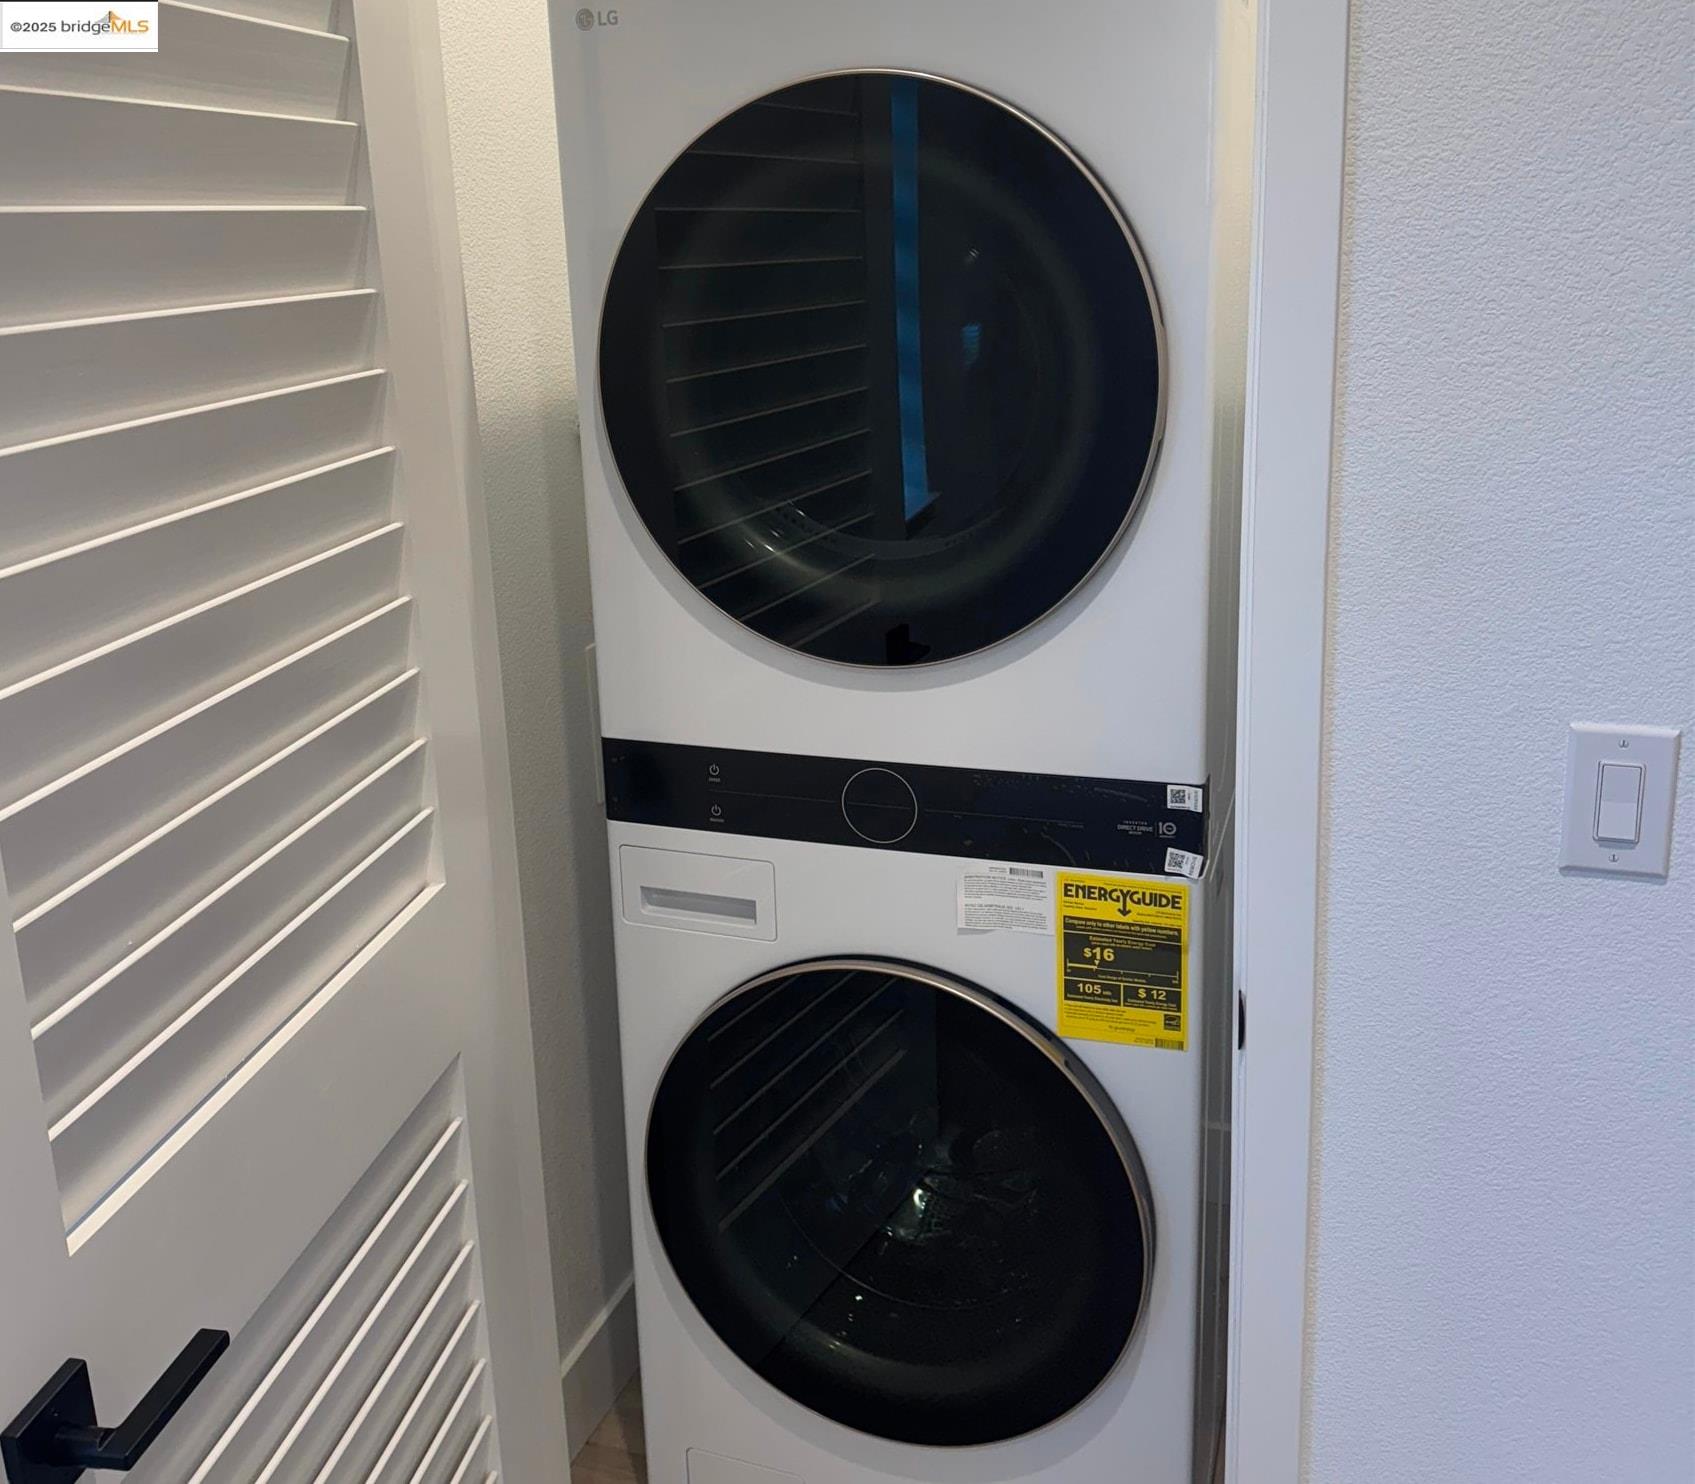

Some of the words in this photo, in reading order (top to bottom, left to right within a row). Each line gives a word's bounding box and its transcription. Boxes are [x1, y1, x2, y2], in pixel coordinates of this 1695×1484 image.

[598, 10, 618, 26] LG
[1063, 883, 1182, 911] ENERGYGUIDE
[1083, 947, 1115, 961] $16
[1077, 983, 1102, 994] 105
[1151, 990, 1167, 1001] 12
